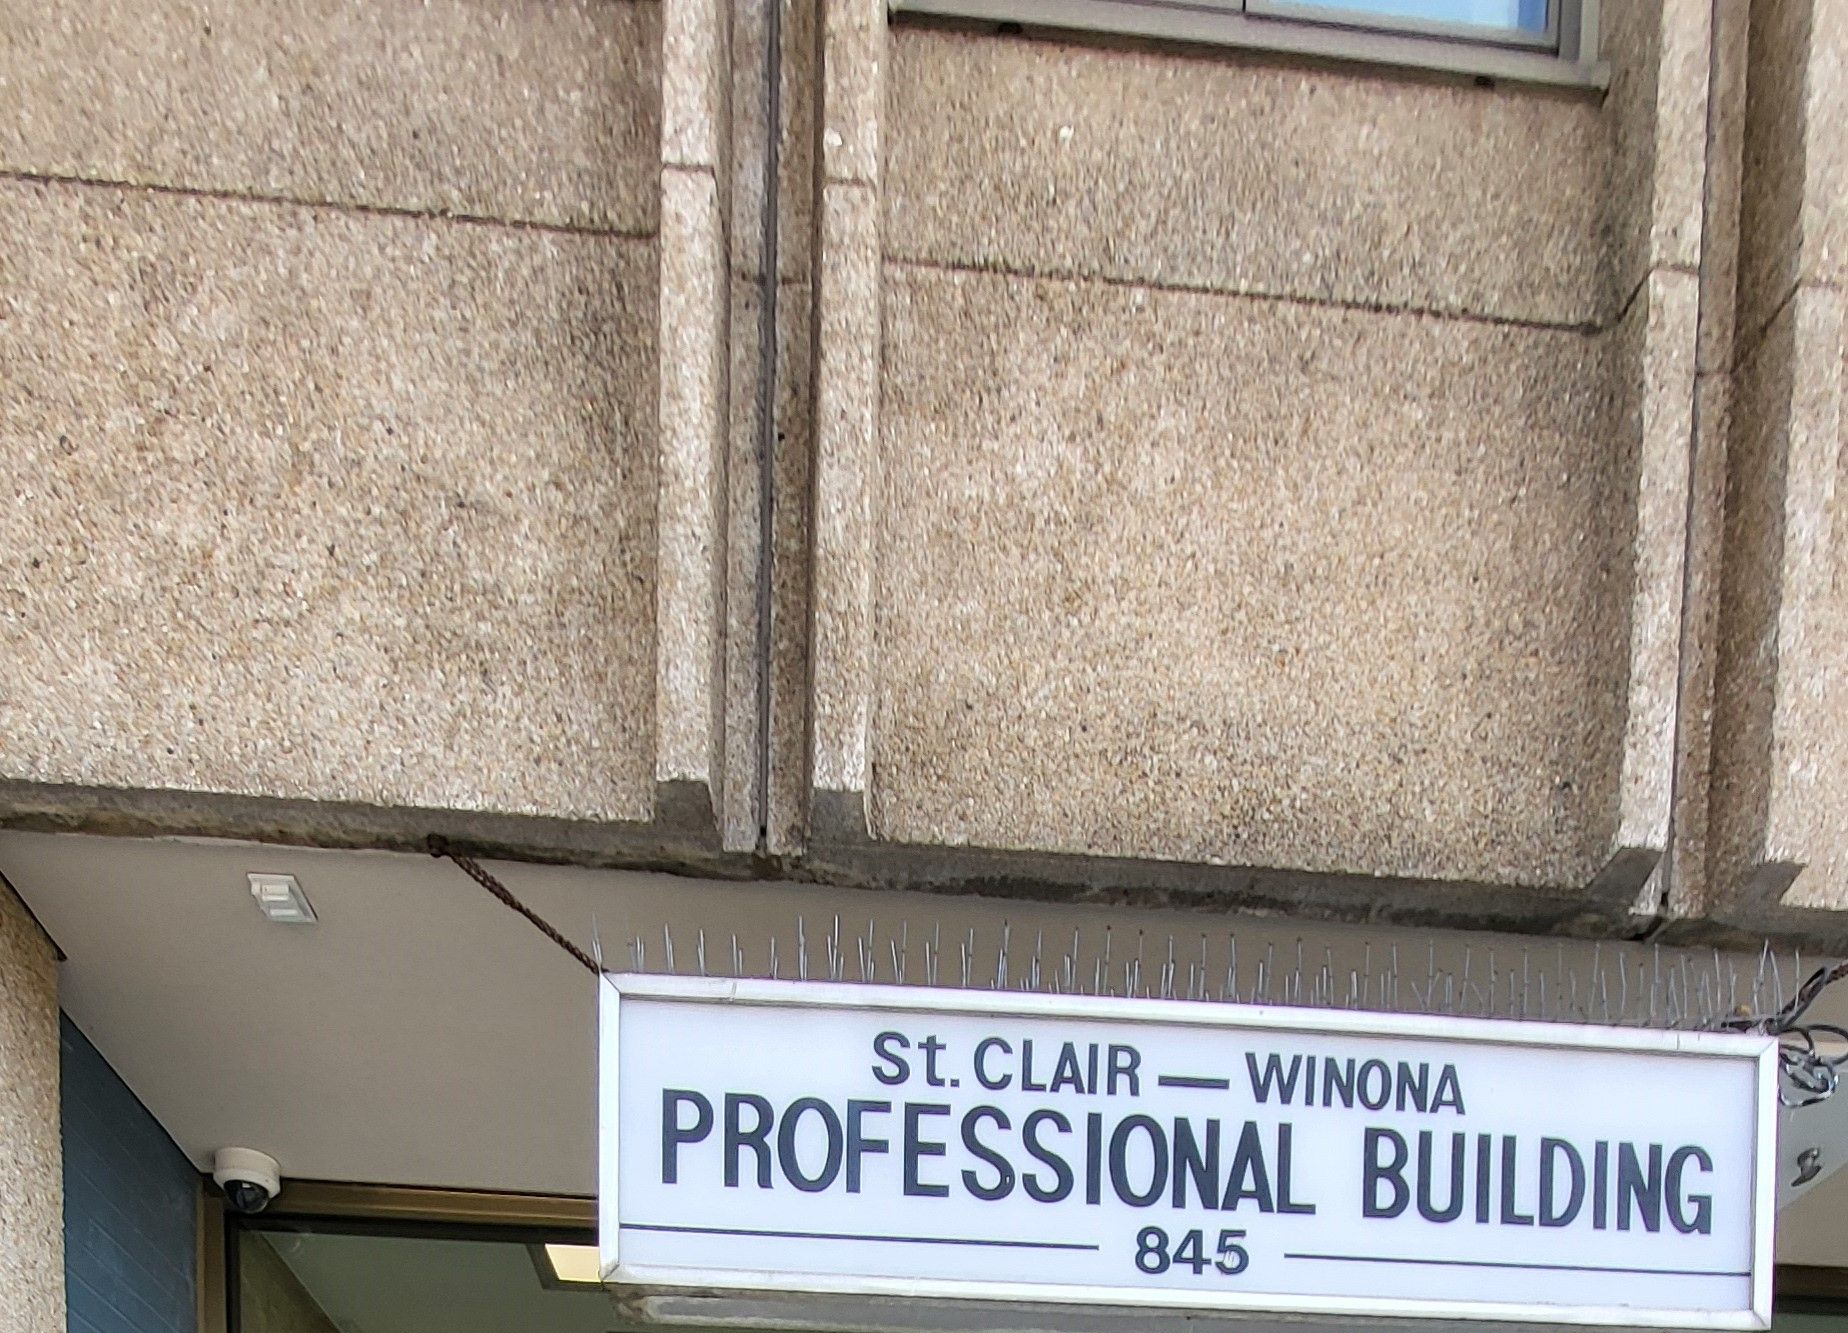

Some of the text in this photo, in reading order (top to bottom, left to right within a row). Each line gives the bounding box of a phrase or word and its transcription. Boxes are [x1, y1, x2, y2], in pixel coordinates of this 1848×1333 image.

[870, 1031, 960, 1088] St.
[973, 1036, 1143, 1097] CLAIR
[1245, 1051, 1466, 1115] WINONA
[660, 1087, 1714, 1235] PROFESSIONAL BUILDING
[1134, 1225, 1250, 1276] 845
